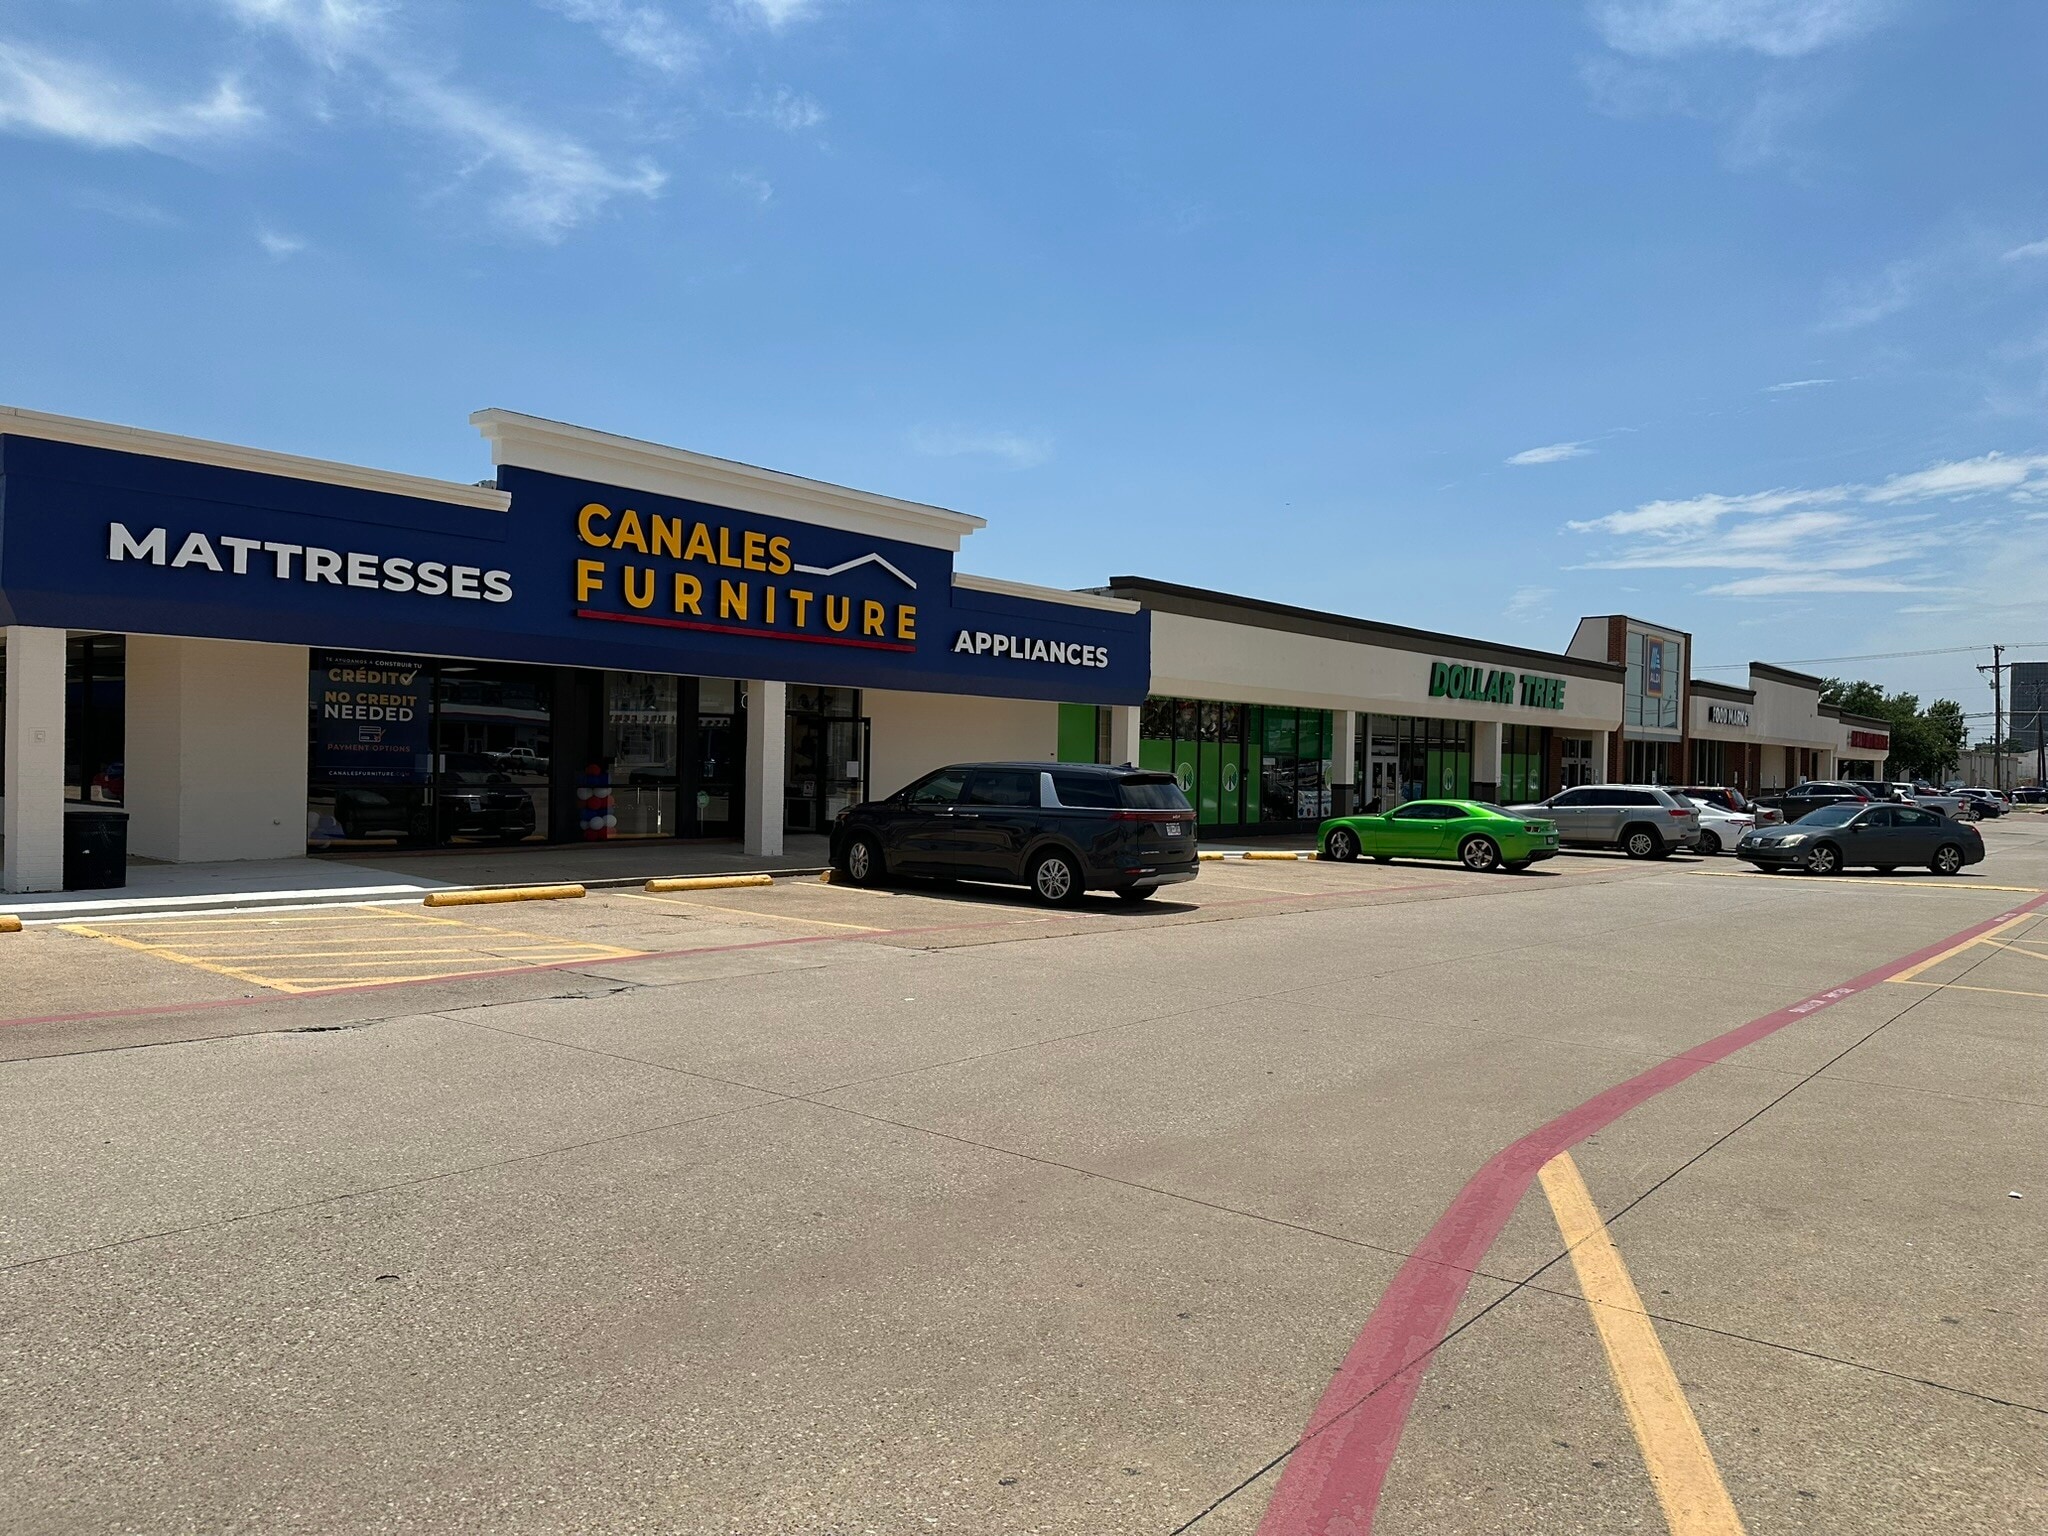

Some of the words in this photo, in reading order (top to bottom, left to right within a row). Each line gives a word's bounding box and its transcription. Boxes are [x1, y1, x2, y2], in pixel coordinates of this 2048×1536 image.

[578, 503, 791, 575] CANALES
[109, 522, 513, 603] MATTRESSES
[577, 559, 916, 640] FURNITURE
[954, 630, 1108, 668] APPLIANCES
[328, 667, 413, 686] CRÉDITO
[375, 660, 412, 669] CONSTRUIR
[325, 691, 350, 704] NO
[356, 693, 417, 707] CREDIT
[1429, 662, 1515, 705] DOLLAR
[1520, 674, 1566, 710] TREE
[324, 704, 413, 721] NEEDED
[327, 743, 369, 752] PAYMENT
[372, 745, 410, 753] OPTIONS
